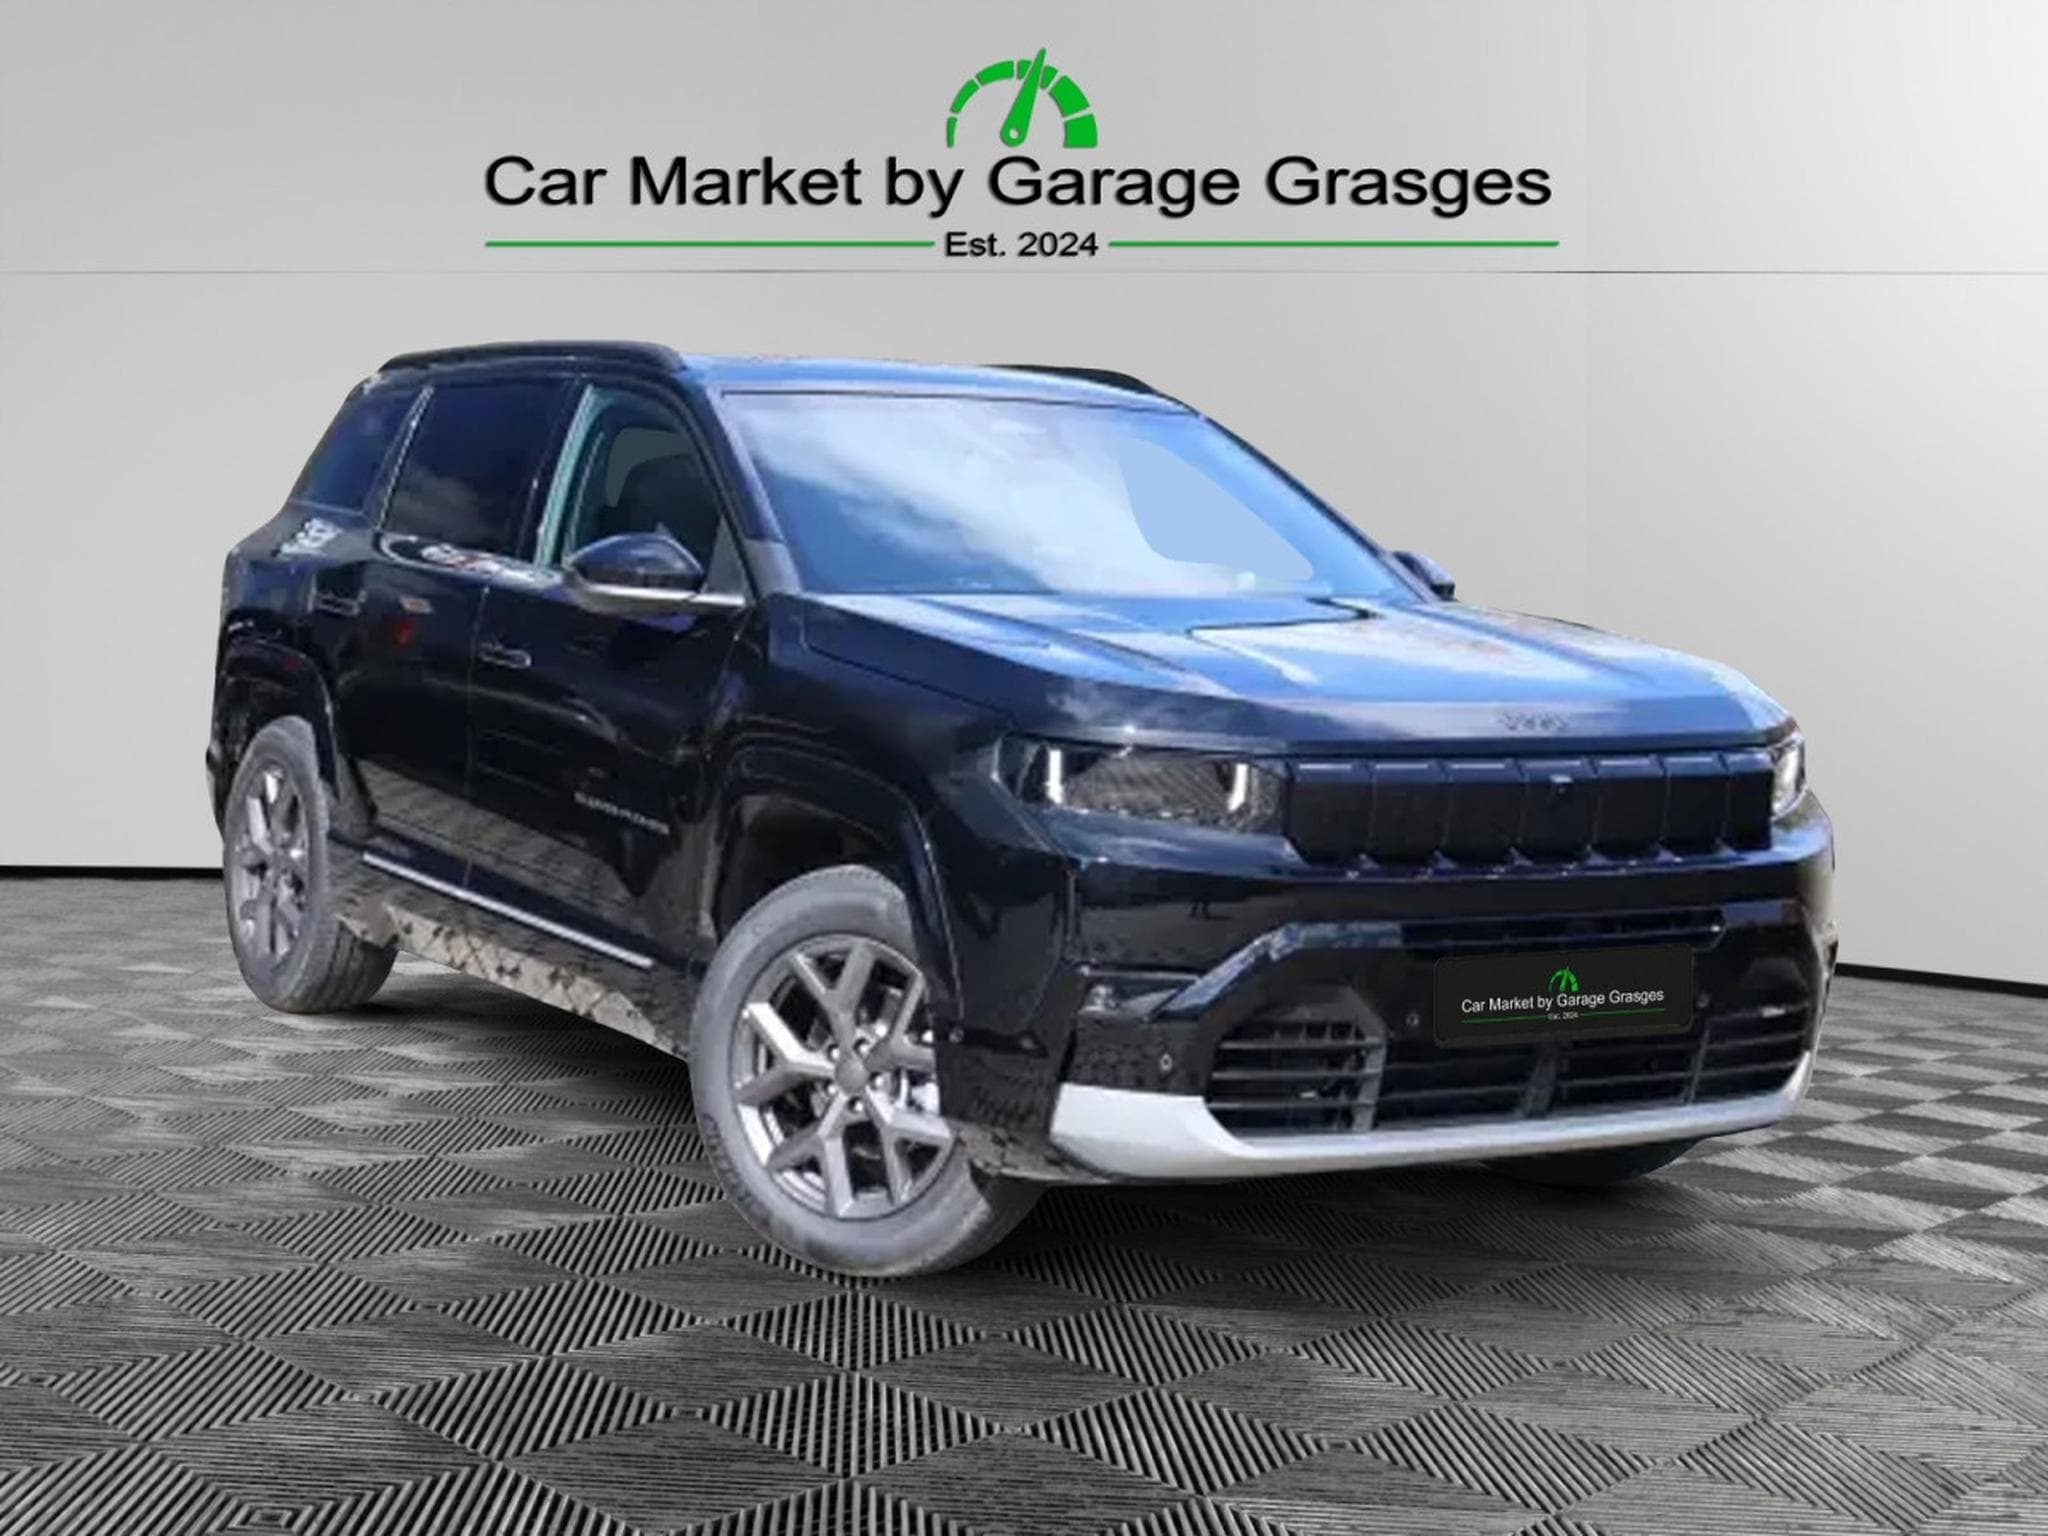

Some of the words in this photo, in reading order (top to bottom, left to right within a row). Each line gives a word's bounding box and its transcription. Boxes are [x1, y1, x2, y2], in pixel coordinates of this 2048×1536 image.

[1461, 998, 1486, 1013] Car
[1488, 996, 1534, 1011] Market
[1537, 994, 1553, 1011] by
[1556, 992, 1606, 1009] Garage
[1608, 989, 1665, 1005] Grasges
